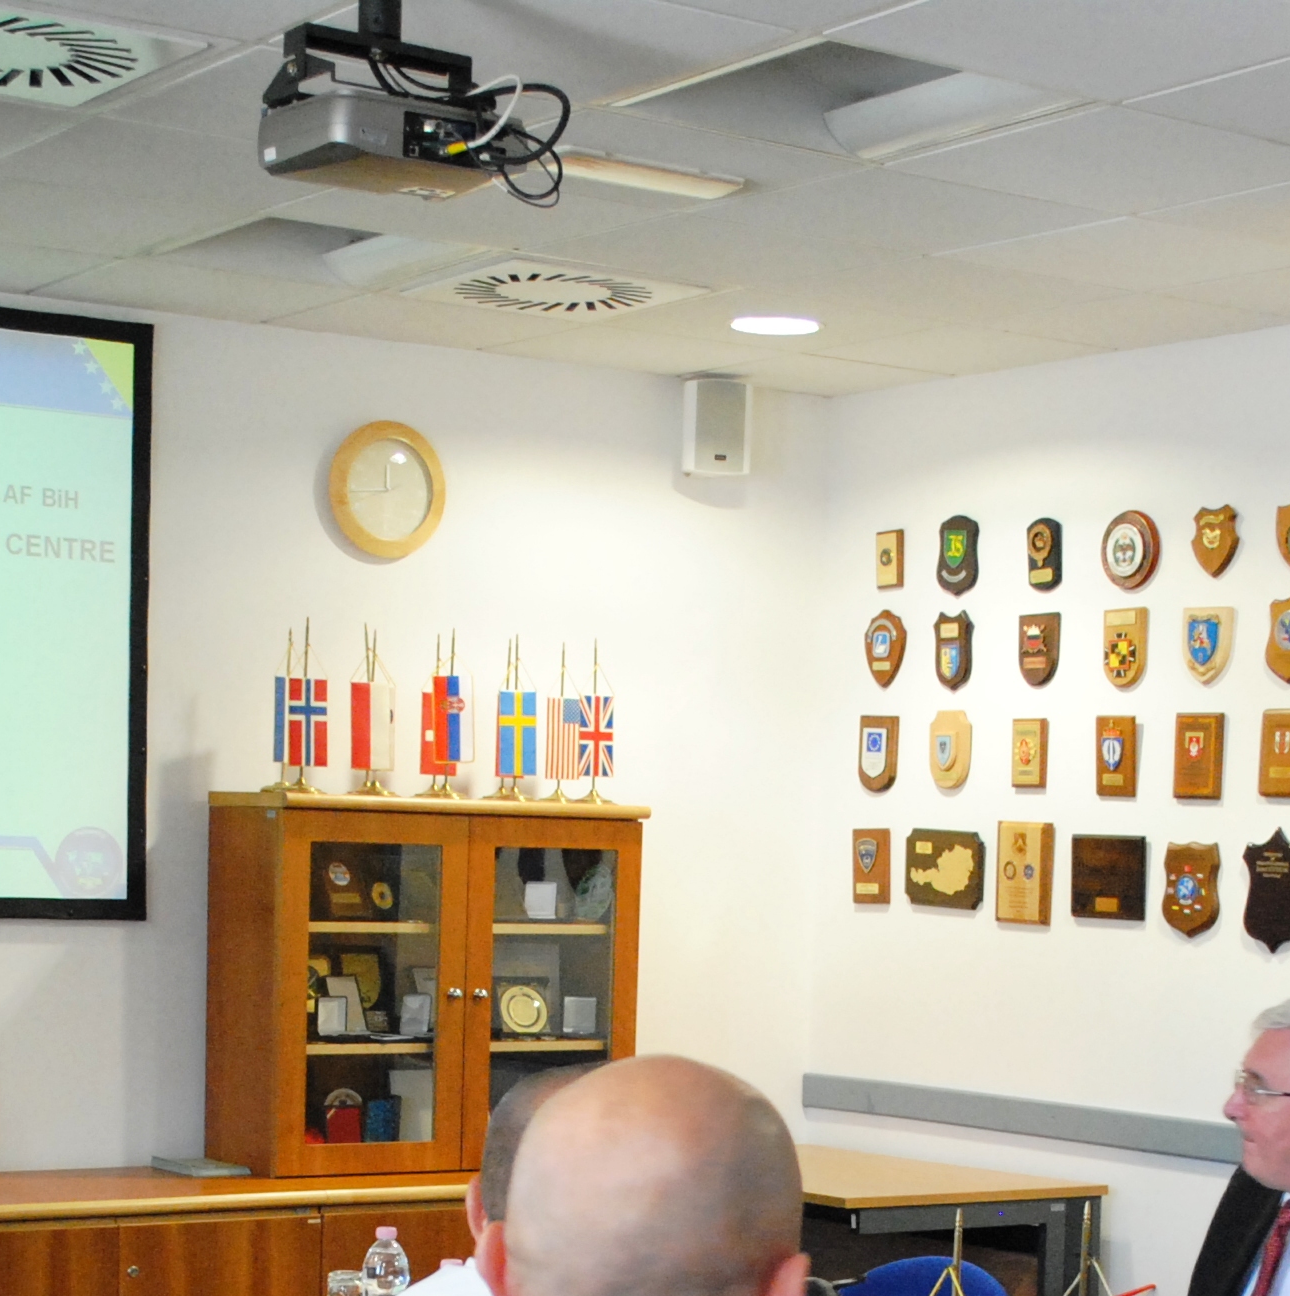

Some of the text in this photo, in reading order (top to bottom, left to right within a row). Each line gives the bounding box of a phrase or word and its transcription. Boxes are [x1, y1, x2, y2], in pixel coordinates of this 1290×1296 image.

[3, 484, 33, 505] AF
[42, 487, 80, 509] BiH
[5, 533, 116, 564] CENTRE
